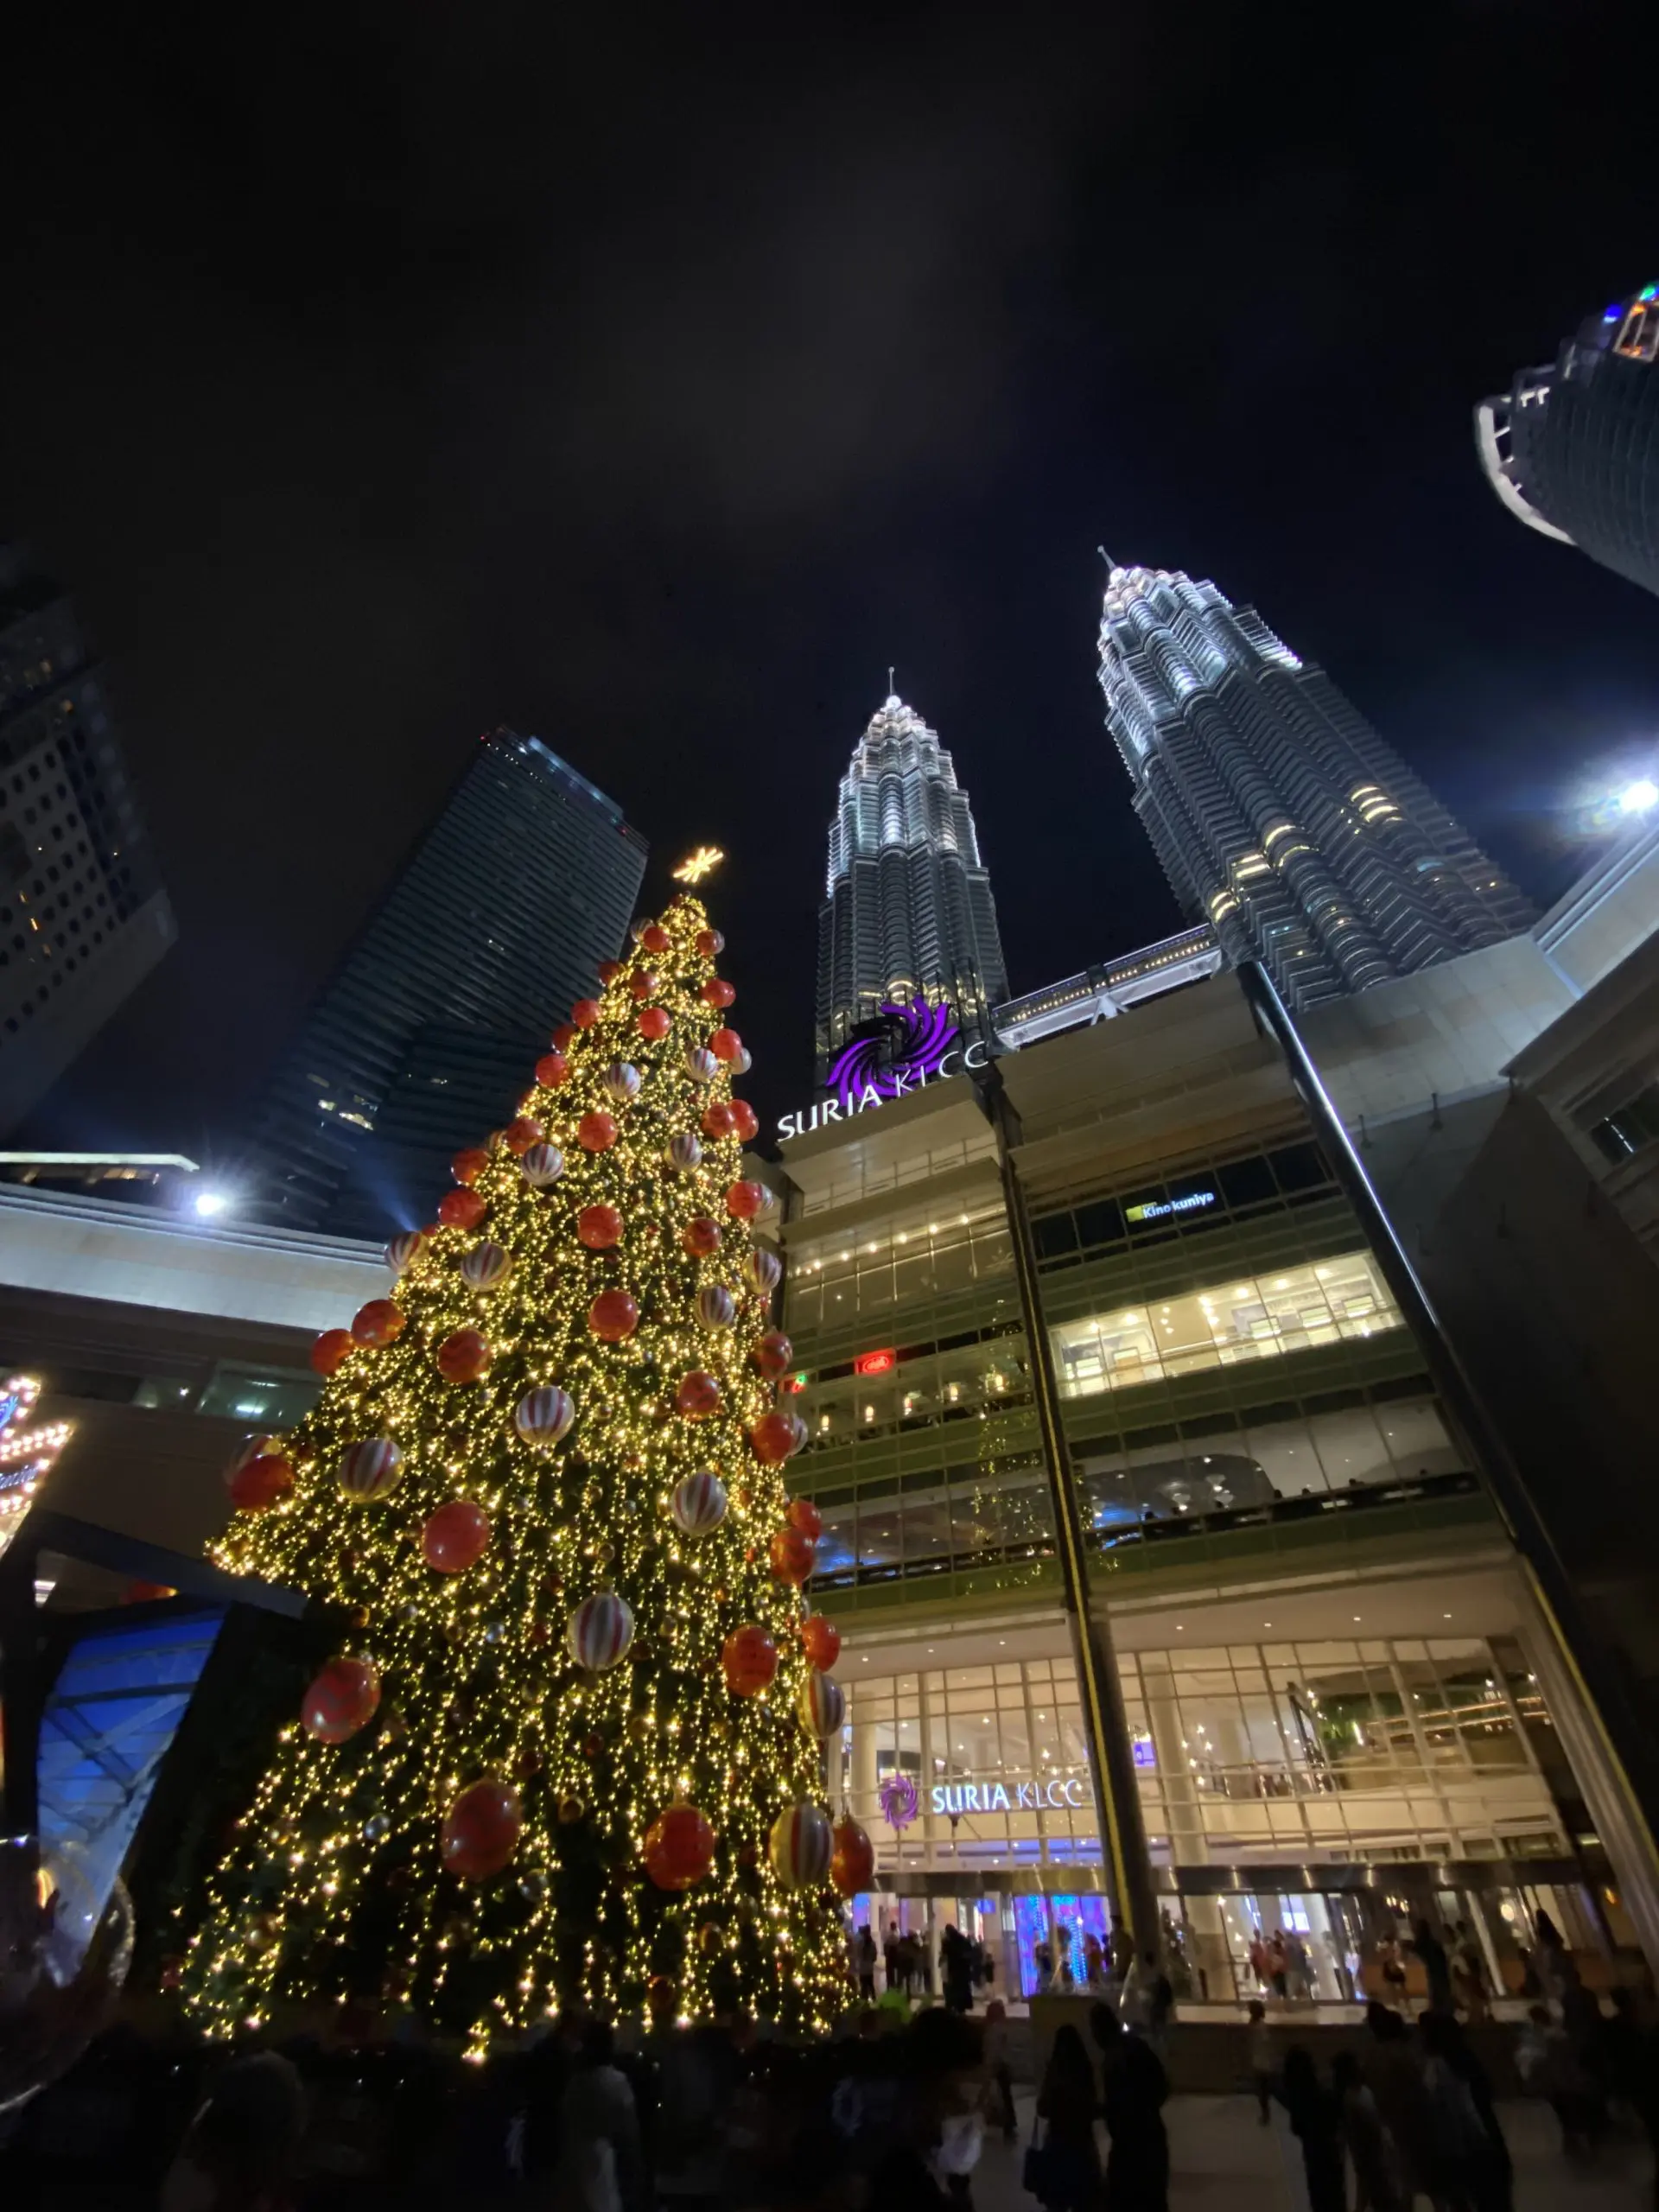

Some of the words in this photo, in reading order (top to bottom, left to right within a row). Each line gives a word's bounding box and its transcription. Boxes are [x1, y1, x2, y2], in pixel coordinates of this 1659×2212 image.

[777, 1084, 883, 1142] SURIA
[931, 1783, 1011, 1814] SURIA
[1016, 1780, 1082, 1808] KLCC
